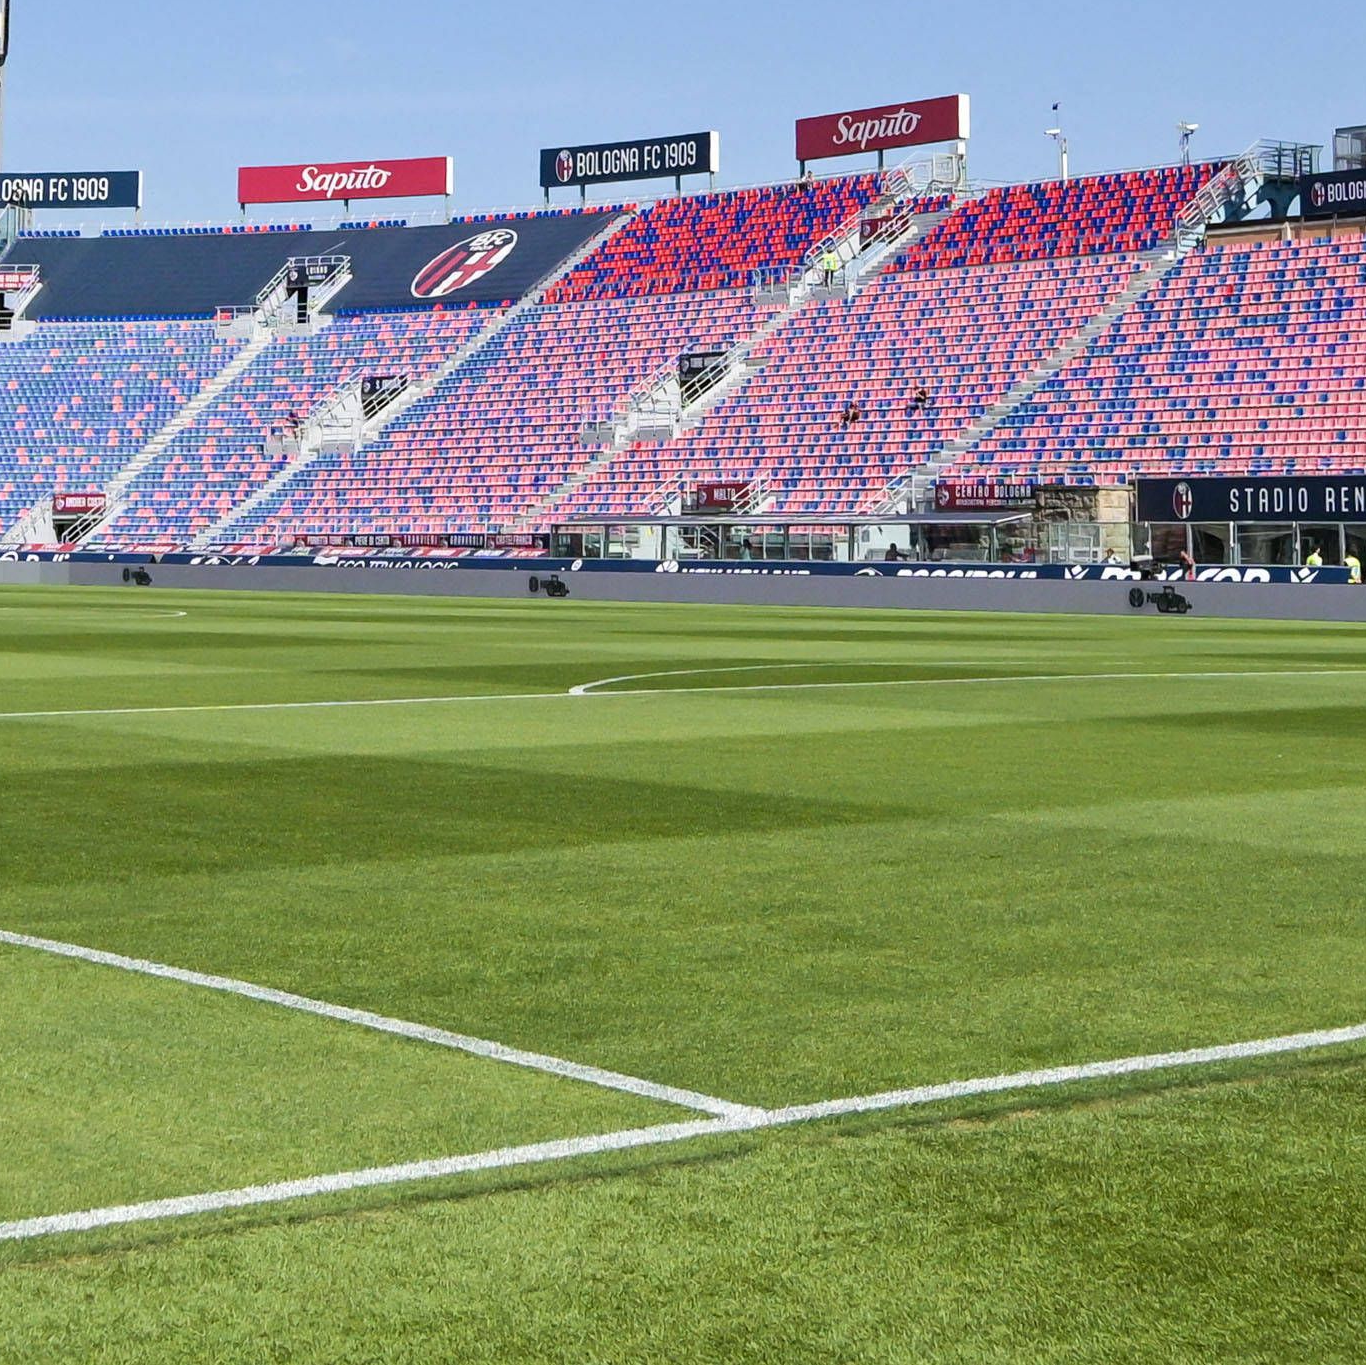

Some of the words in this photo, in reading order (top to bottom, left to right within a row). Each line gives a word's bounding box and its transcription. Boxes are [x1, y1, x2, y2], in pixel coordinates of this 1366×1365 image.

[833, 108, 921, 149] Saputo
[576, 148, 639, 177] BOLOGNA
[644, 145, 661, 171] FC
[664, 141, 697, 168] 1909
[49, 177, 68, 201] FC
[72, 177, 109, 200] 1909
[296, 164, 391, 198] Saputo
[955, 486, 989, 498] CENTRO
[994, 485, 1032, 498] BOLOGNA
[1229, 487, 1308, 513] STADIO
